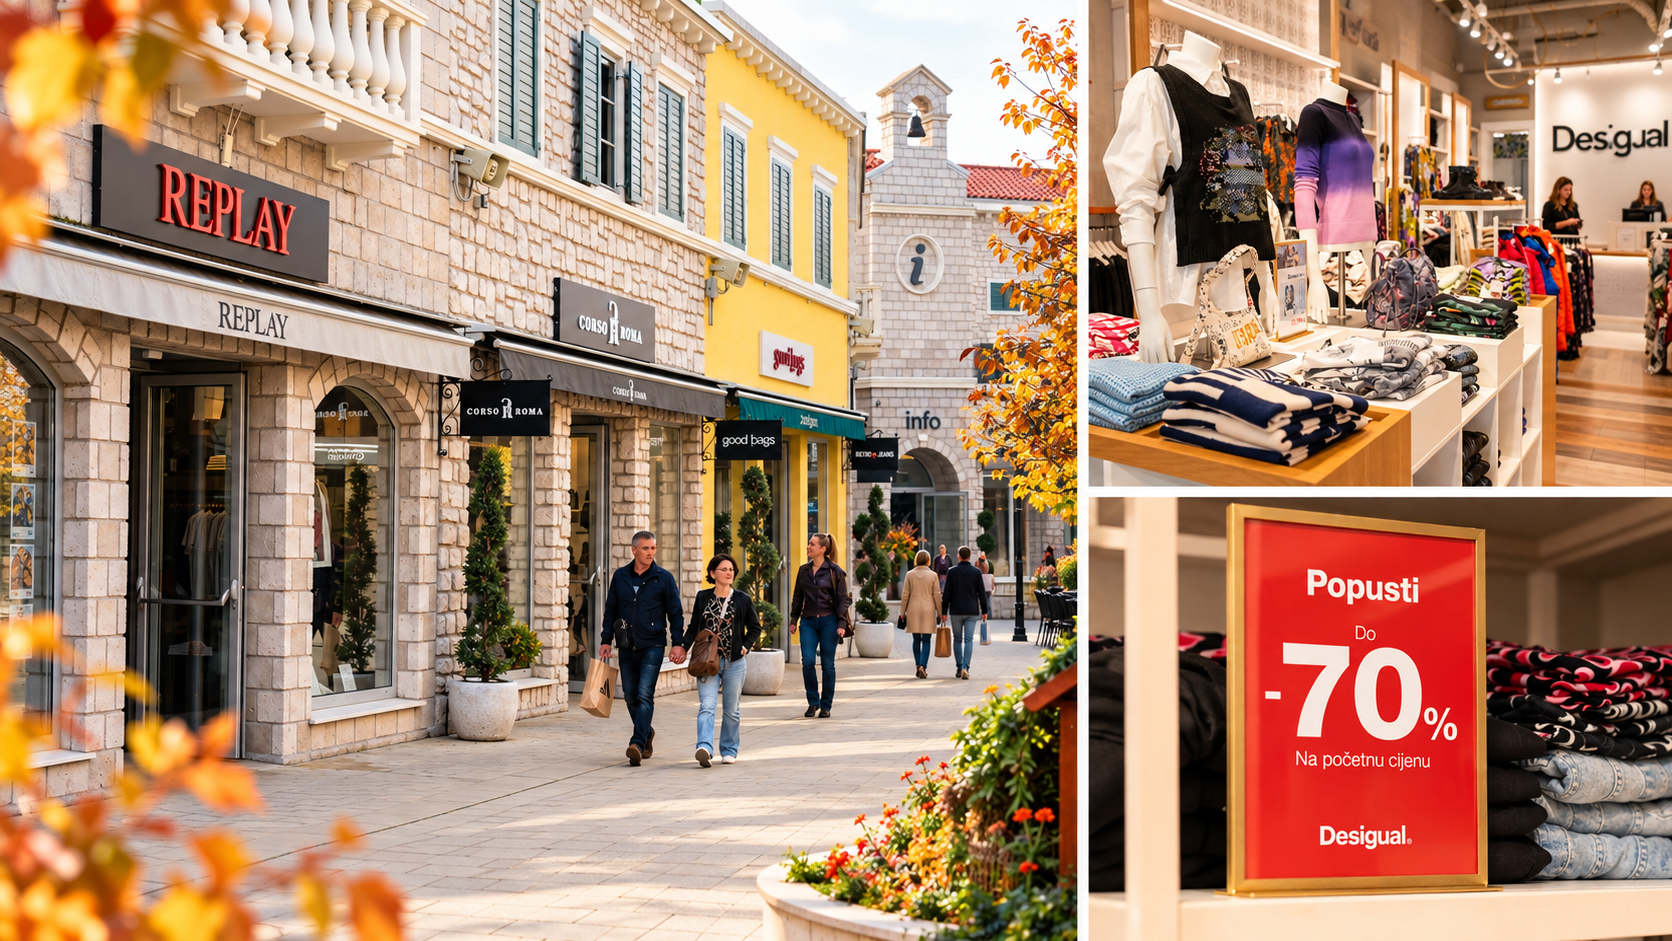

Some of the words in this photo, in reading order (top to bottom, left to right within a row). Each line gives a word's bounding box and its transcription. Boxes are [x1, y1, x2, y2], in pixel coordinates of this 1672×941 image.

[158, 163, 297, 256] REPLAY
[218, 300, 289, 341] REPLAY
[578, 314, 608, 336] CORSO
[620, 325, 643, 345] ROMA
[466, 407, 500, 416] CORSO
[514, 407, 544, 416] ROMA
[905, 410, 942, 430] info
[722, 434, 749, 448] good
[750, 434, 776, 448] bags
[1307, 568, 1420, 605] Popusti
[1355, 625, 1377, 641] Do
[1264, 642, 1458, 741] -70%
[1295, 750, 1318, 767] Na
[1322, 751, 1384, 770] početnu
[1388, 752, 1431, 772] cijenu
